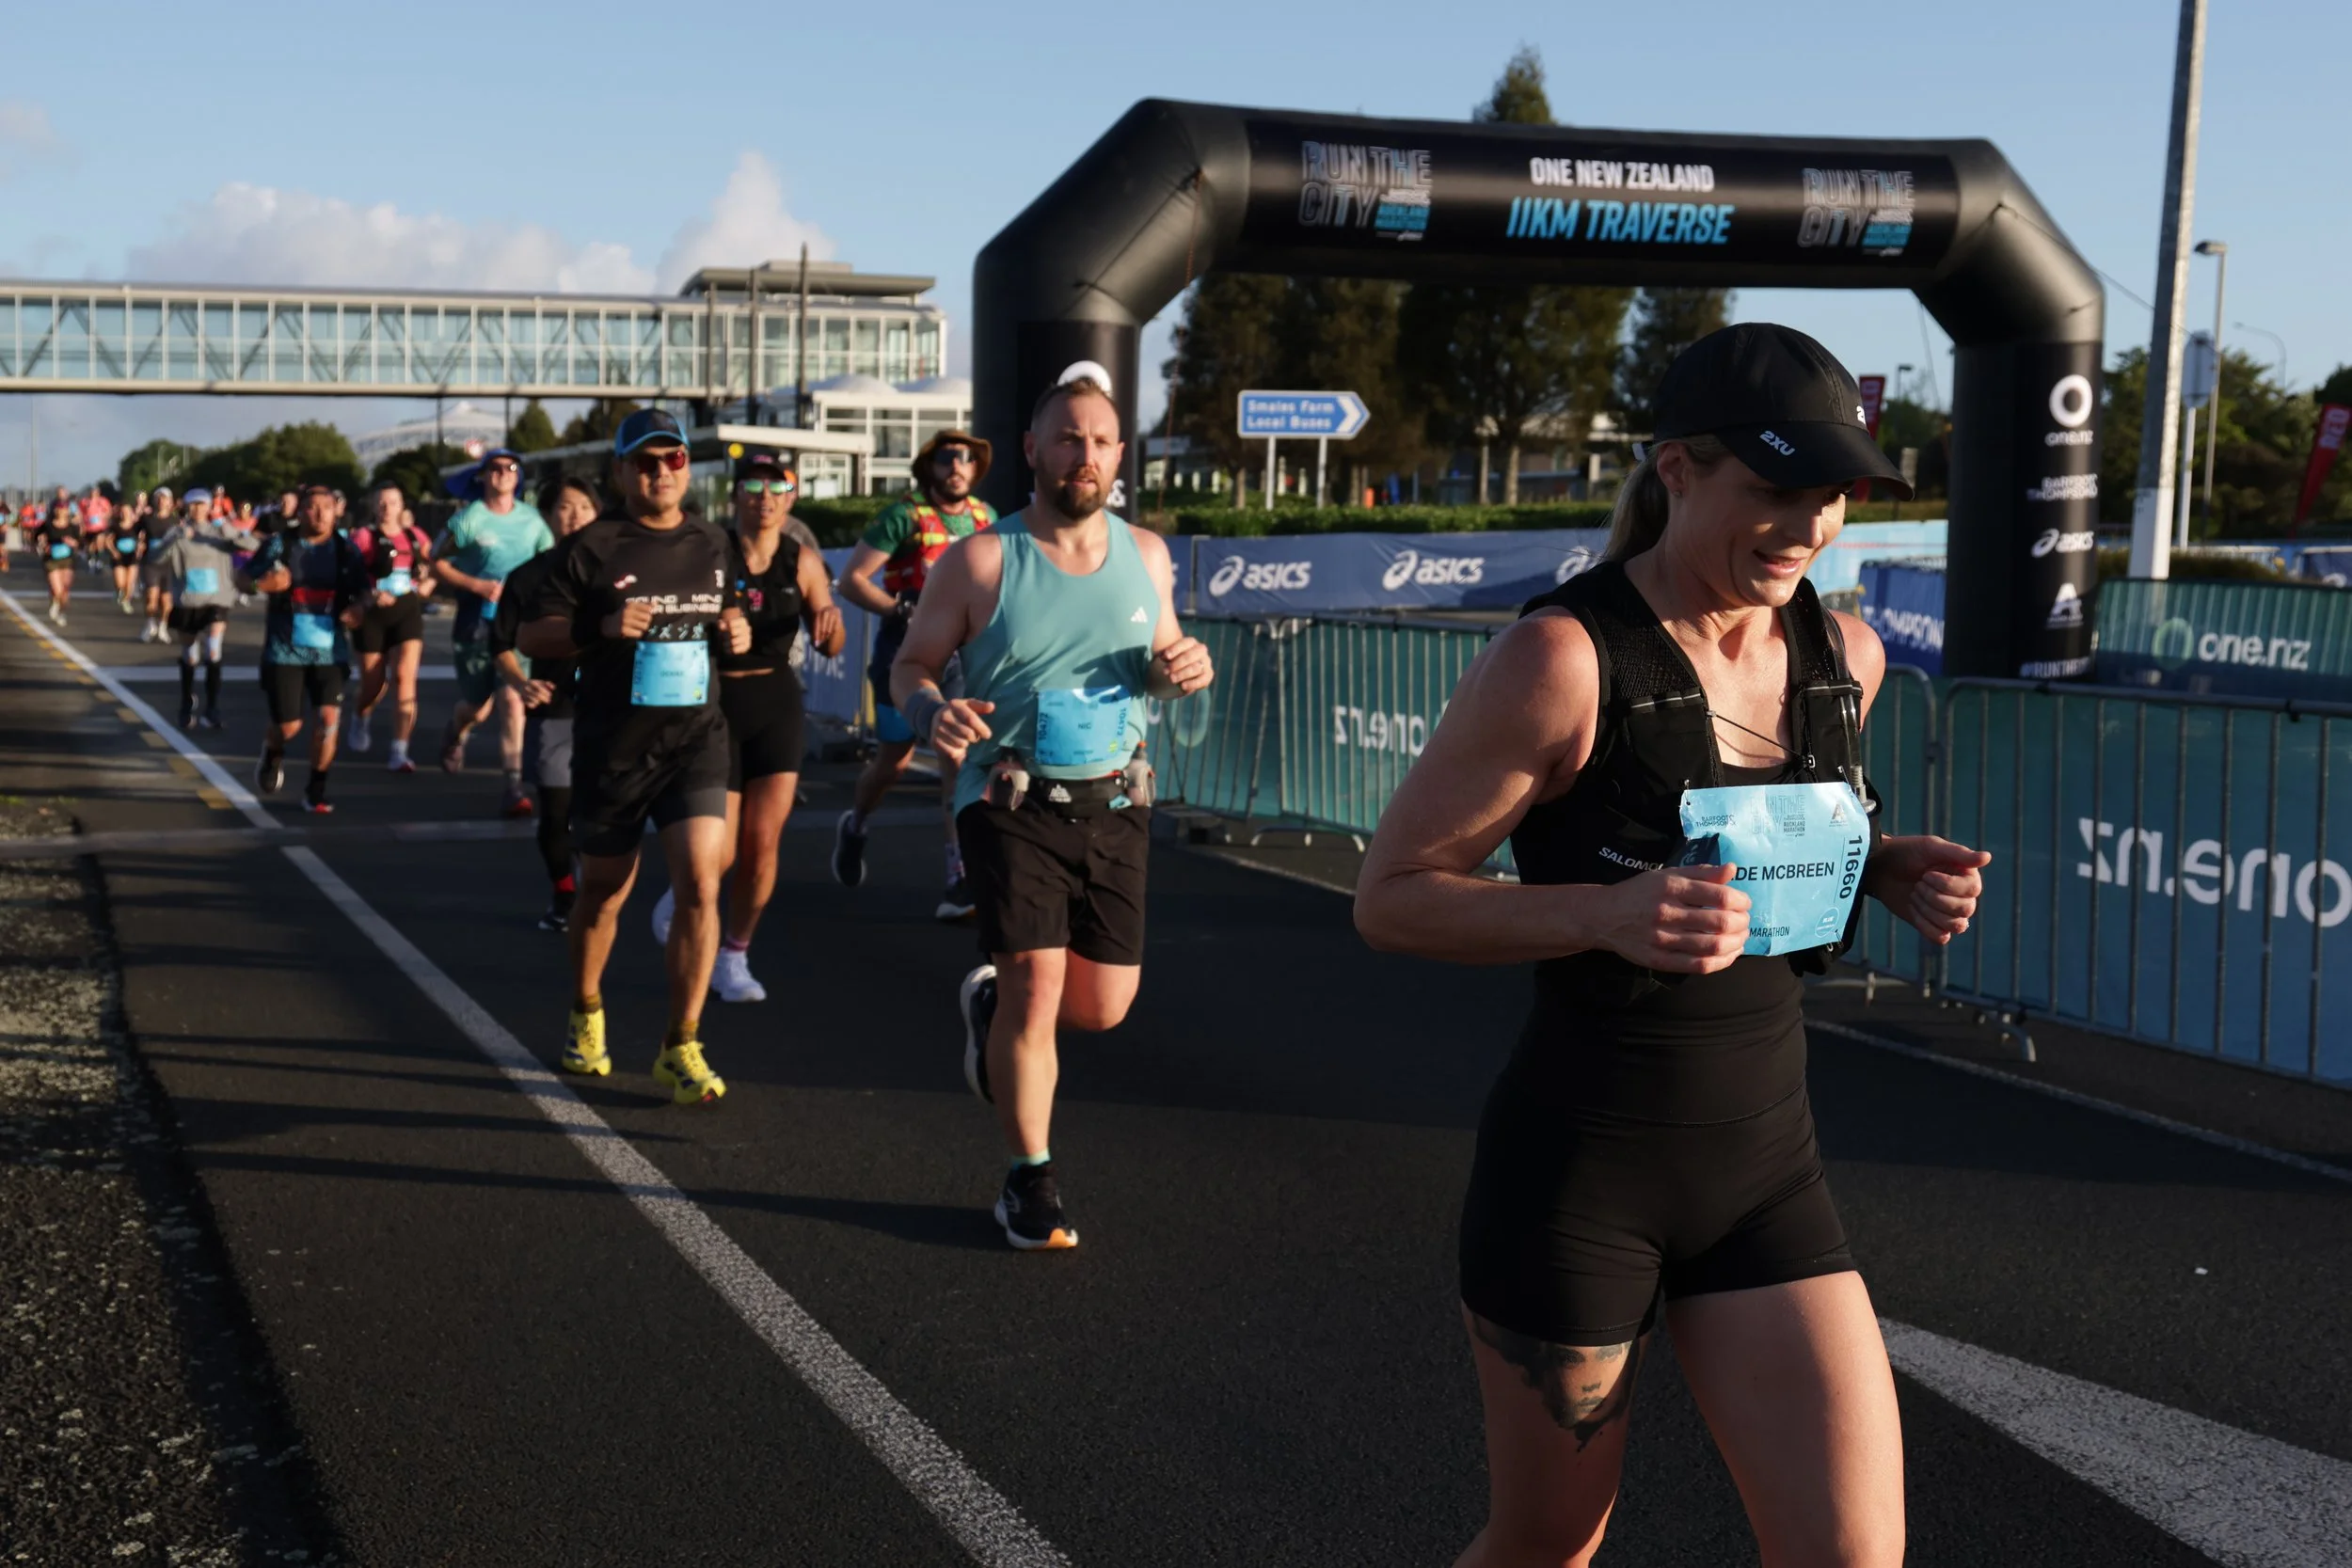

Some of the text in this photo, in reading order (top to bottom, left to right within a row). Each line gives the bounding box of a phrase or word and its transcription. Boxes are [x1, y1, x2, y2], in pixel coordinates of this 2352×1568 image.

[1302, 141, 1432, 186] RUN THE
[1530, 157, 1715, 193] ONE NEW ZEALAND
[1298, 182, 1379, 229] CITY
[1803, 167, 1915, 209] RUN THE
[1506, 197, 1735, 245] 11KM TRAVERSE
[1797, 206, 1870, 248] CITY
[1248, 415, 1331, 429] Local Buses
[1300, 399, 1334, 414] Farm
[1759, 430, 1796, 456] 2XU
[1242, 561, 1311, 591] asics
[1415, 558, 1485, 585] asics
[2198, 633, 2312, 672] one.nz
[1731, 862, 1836, 881] DE MCBREEN
[1839, 835, 1863, 899] 11660
[1750, 926, 1790, 938] MARATHON
